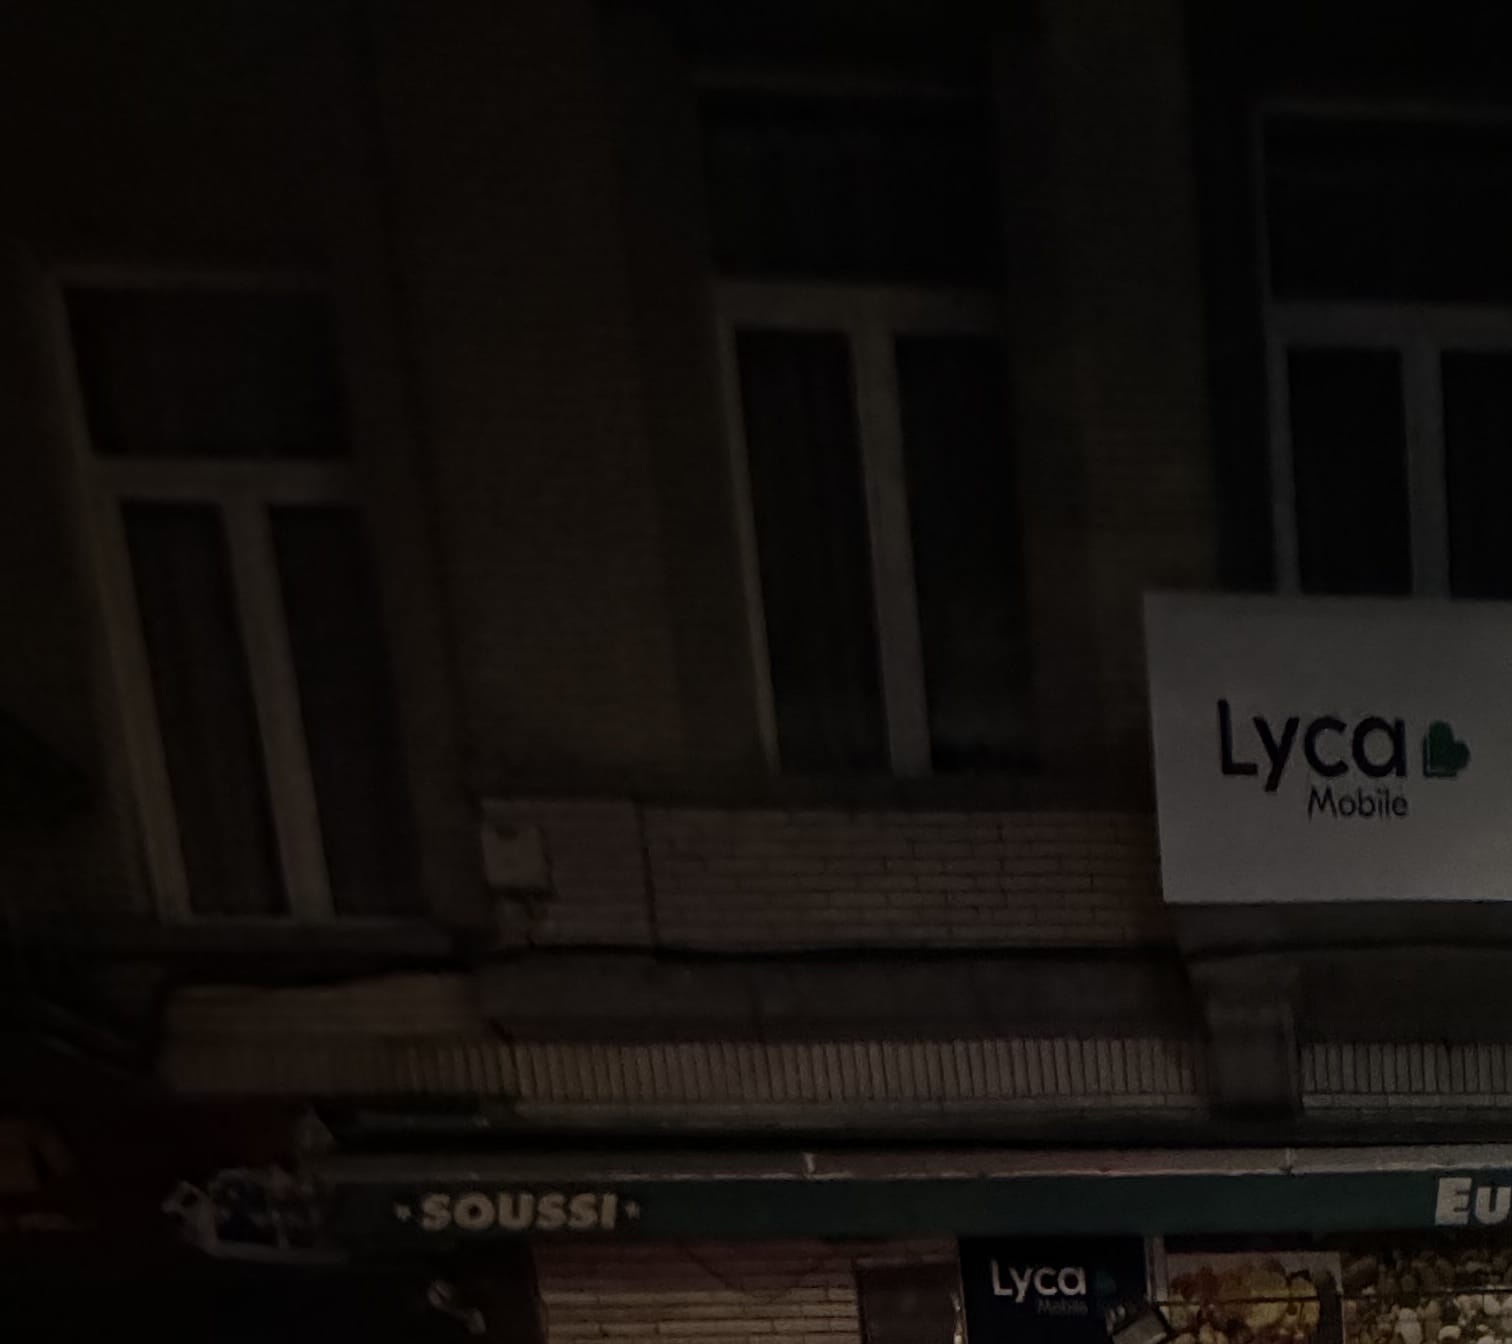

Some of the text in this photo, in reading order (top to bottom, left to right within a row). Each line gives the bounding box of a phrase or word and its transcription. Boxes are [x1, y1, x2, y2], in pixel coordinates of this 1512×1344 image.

[1217, 699, 1408, 793] Lyca
[1307, 785, 1409, 820] Mobile
[419, 1190, 620, 1233] SOUSSI
[990, 1256, 1089, 1304] Lyca
